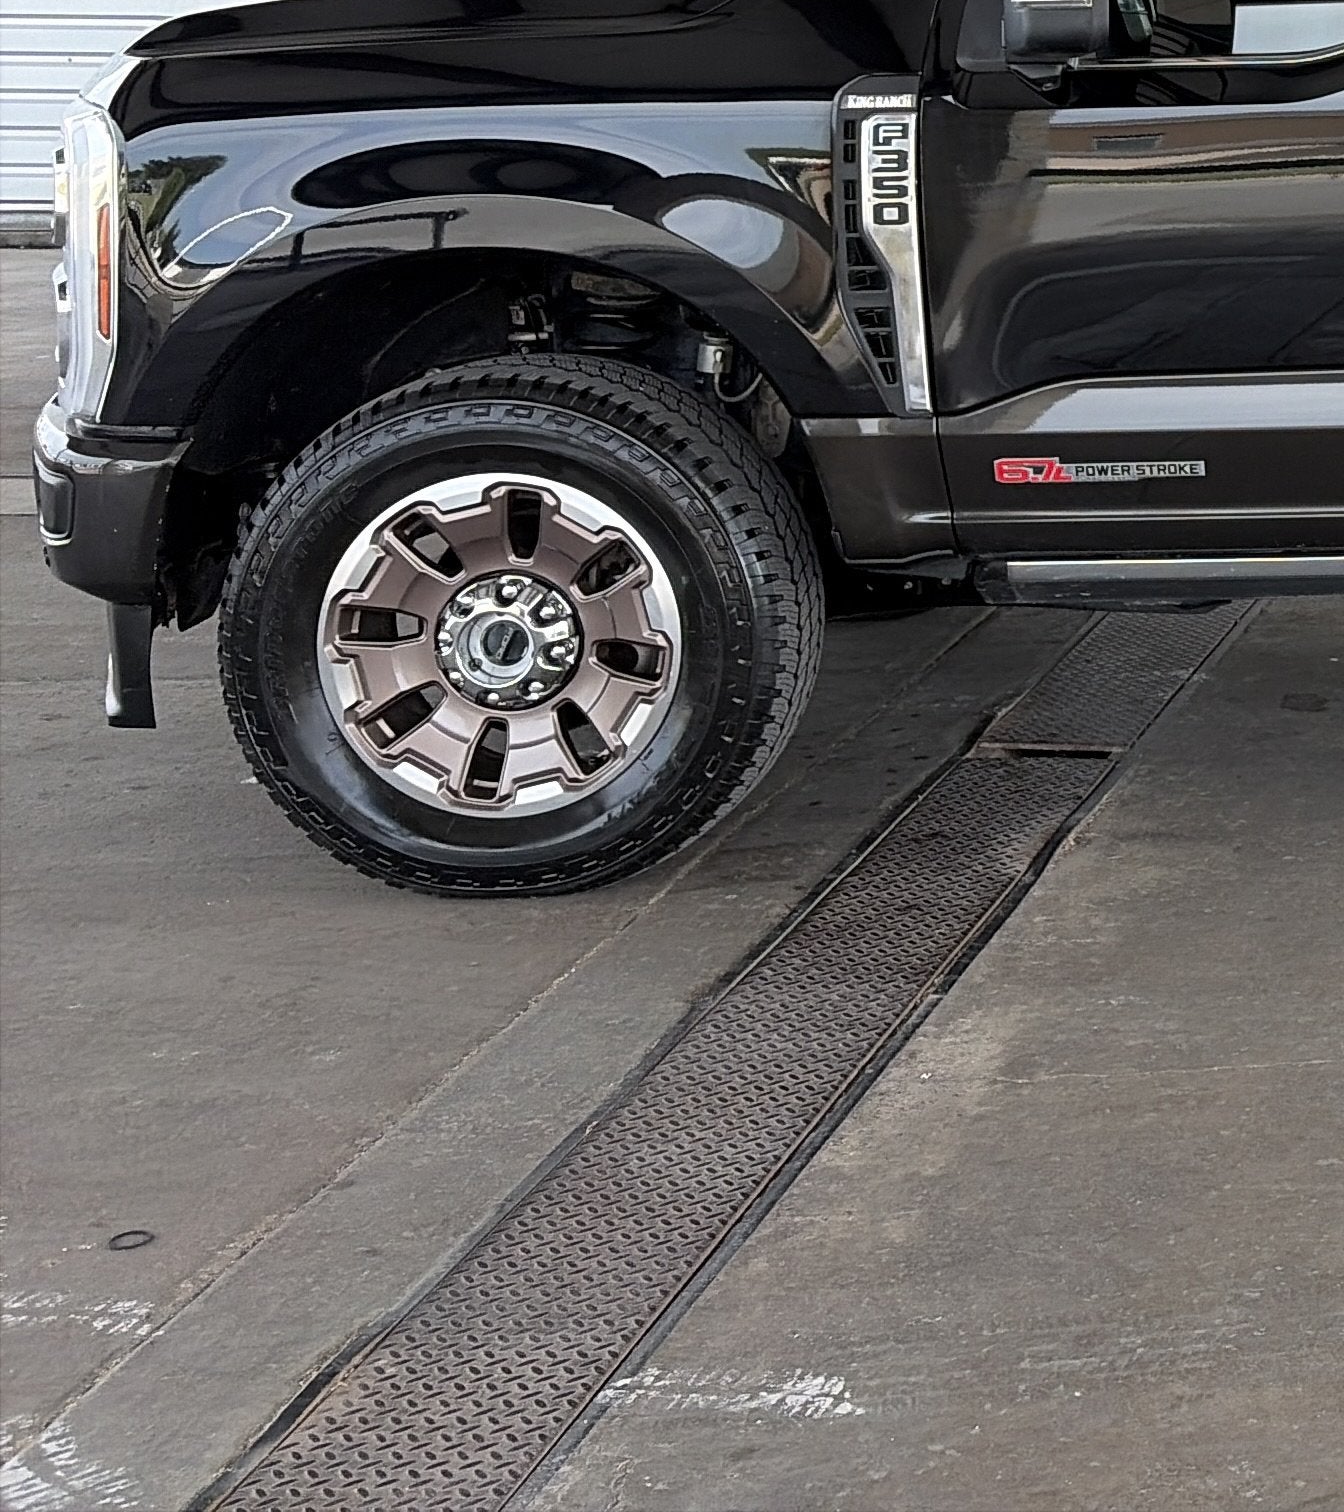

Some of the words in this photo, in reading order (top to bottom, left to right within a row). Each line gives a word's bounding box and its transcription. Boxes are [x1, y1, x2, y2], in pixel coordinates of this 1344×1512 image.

[875, 94, 913, 108] RANCH
[1075, 464, 1131, 477] POWER
[1136, 463, 1200, 476] STROKE
